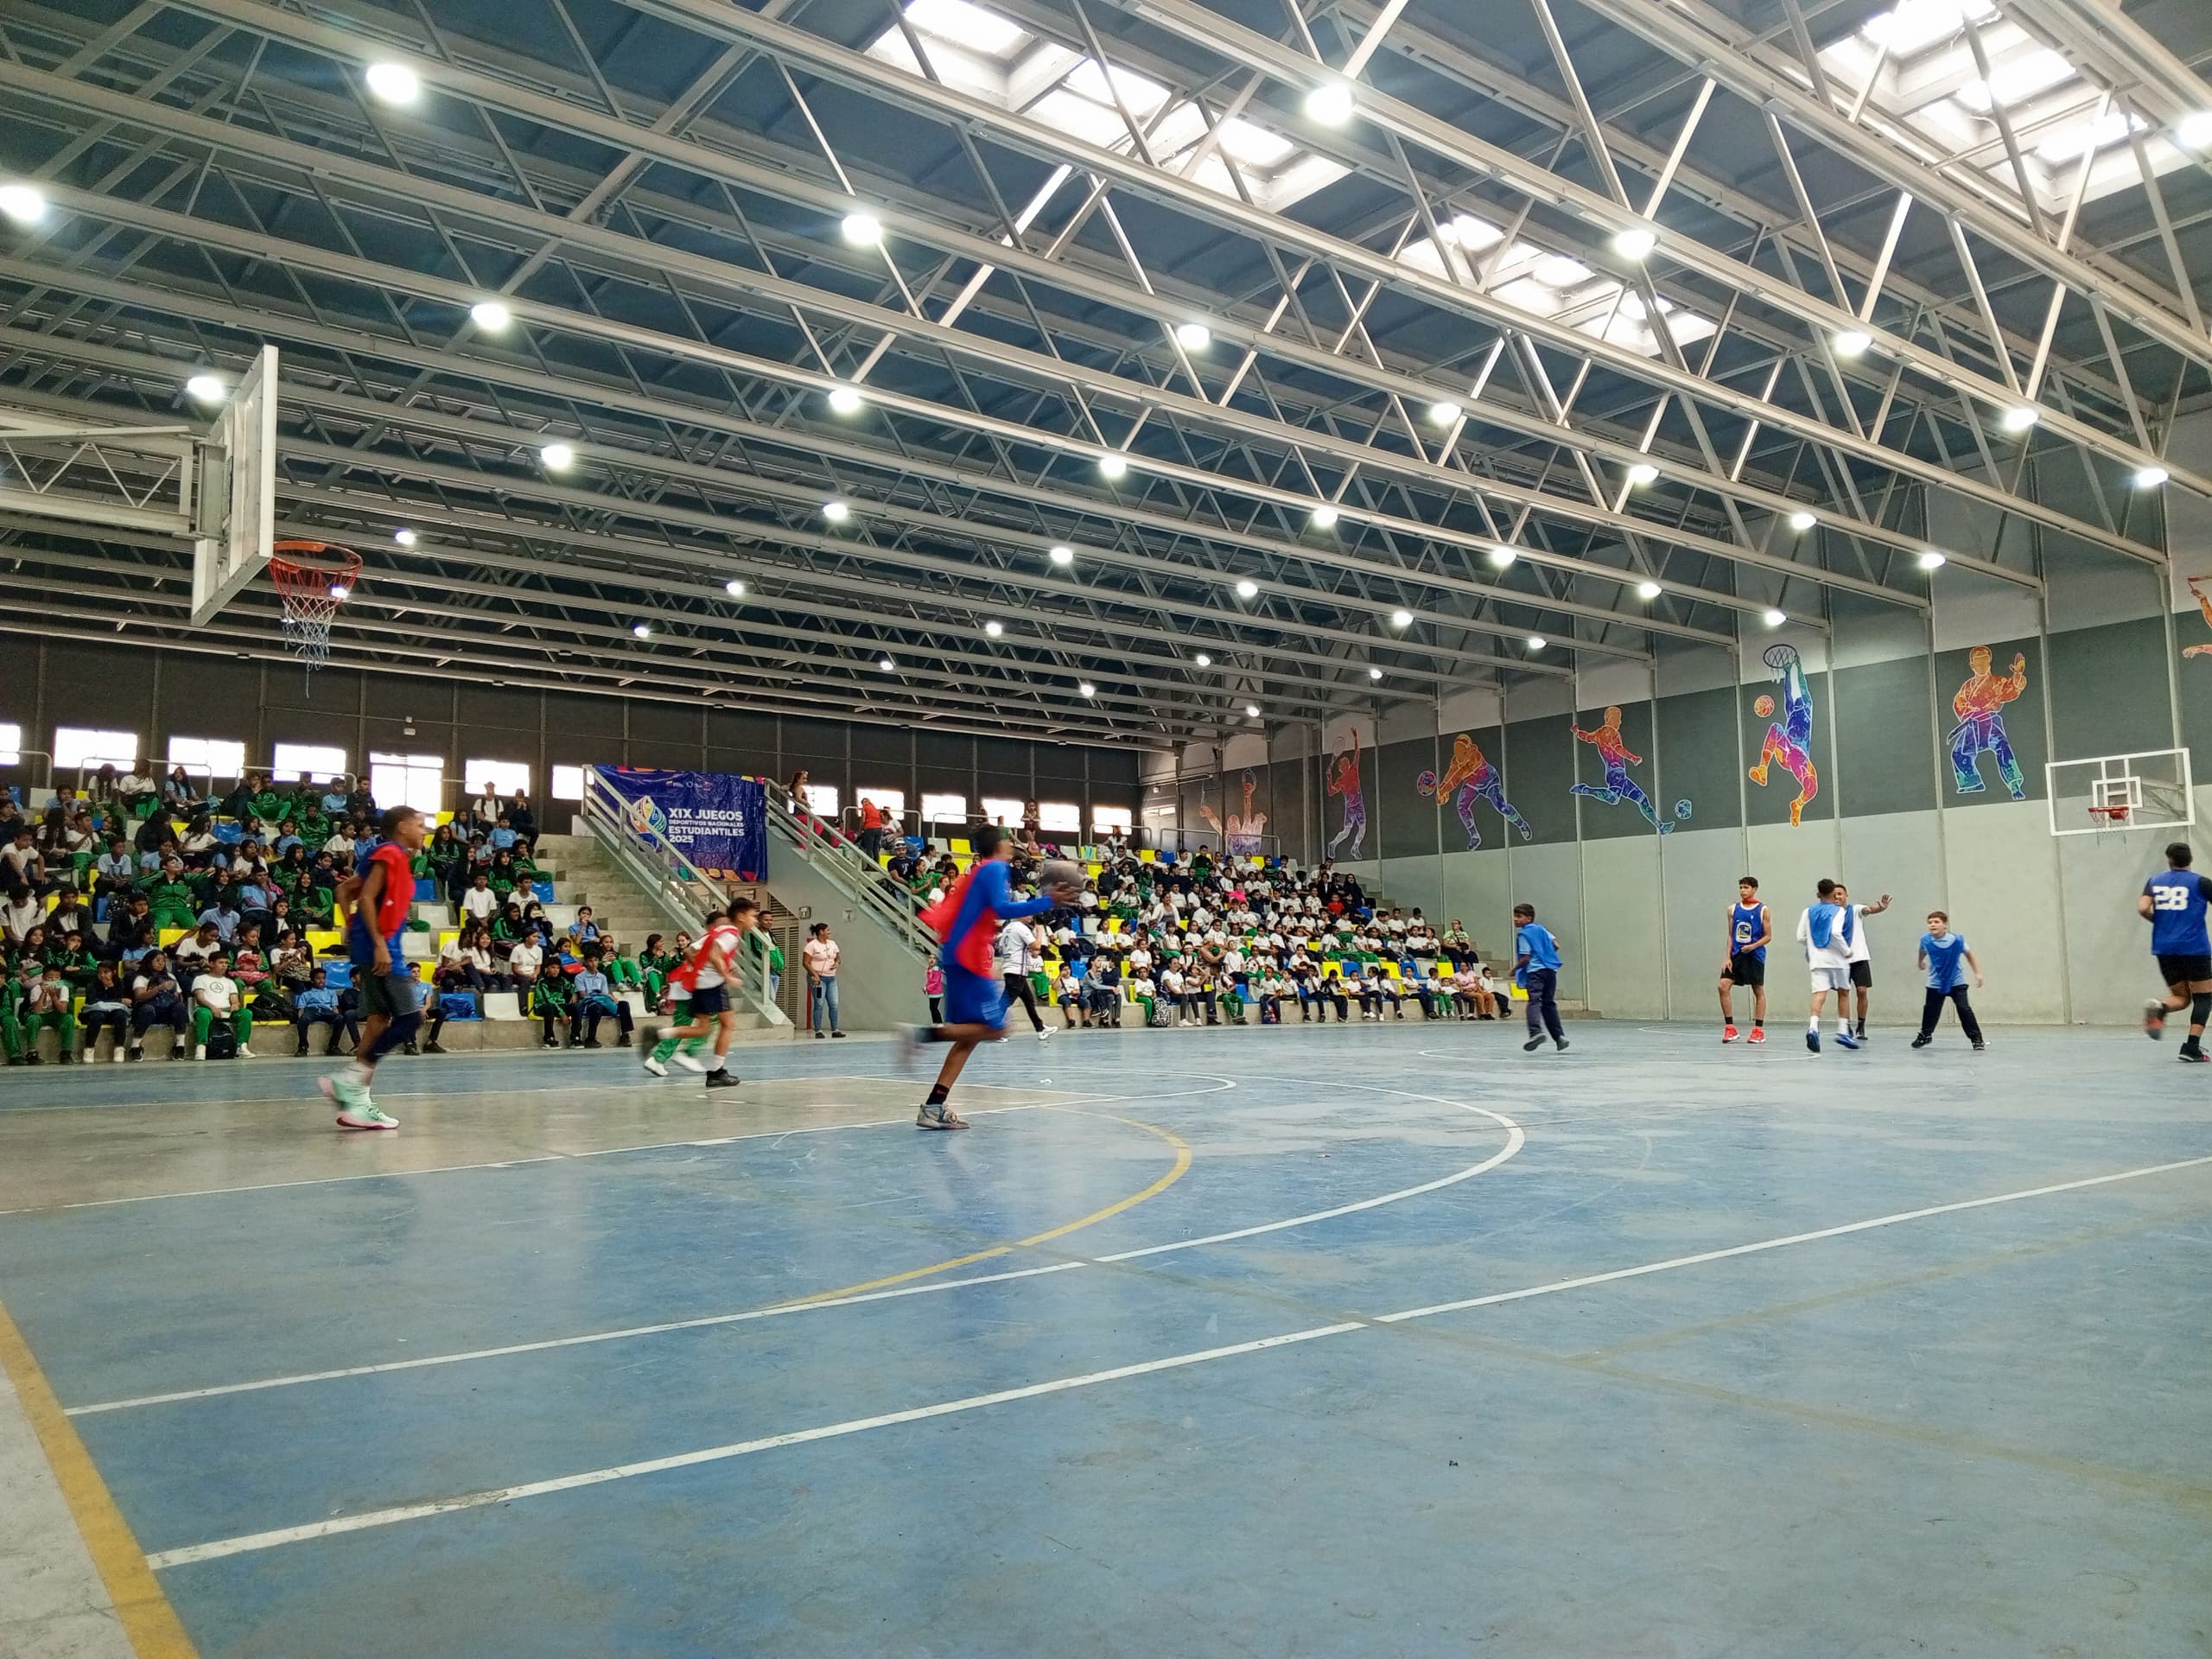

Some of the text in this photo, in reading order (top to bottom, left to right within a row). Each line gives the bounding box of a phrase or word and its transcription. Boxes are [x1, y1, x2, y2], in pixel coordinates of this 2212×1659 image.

[669, 808, 743, 821] XIX JUEGOS
[669, 826, 745, 836] ESTUDIANTILES
[669, 835, 694, 843] 2025
[2152, 885, 2190, 911] 28
